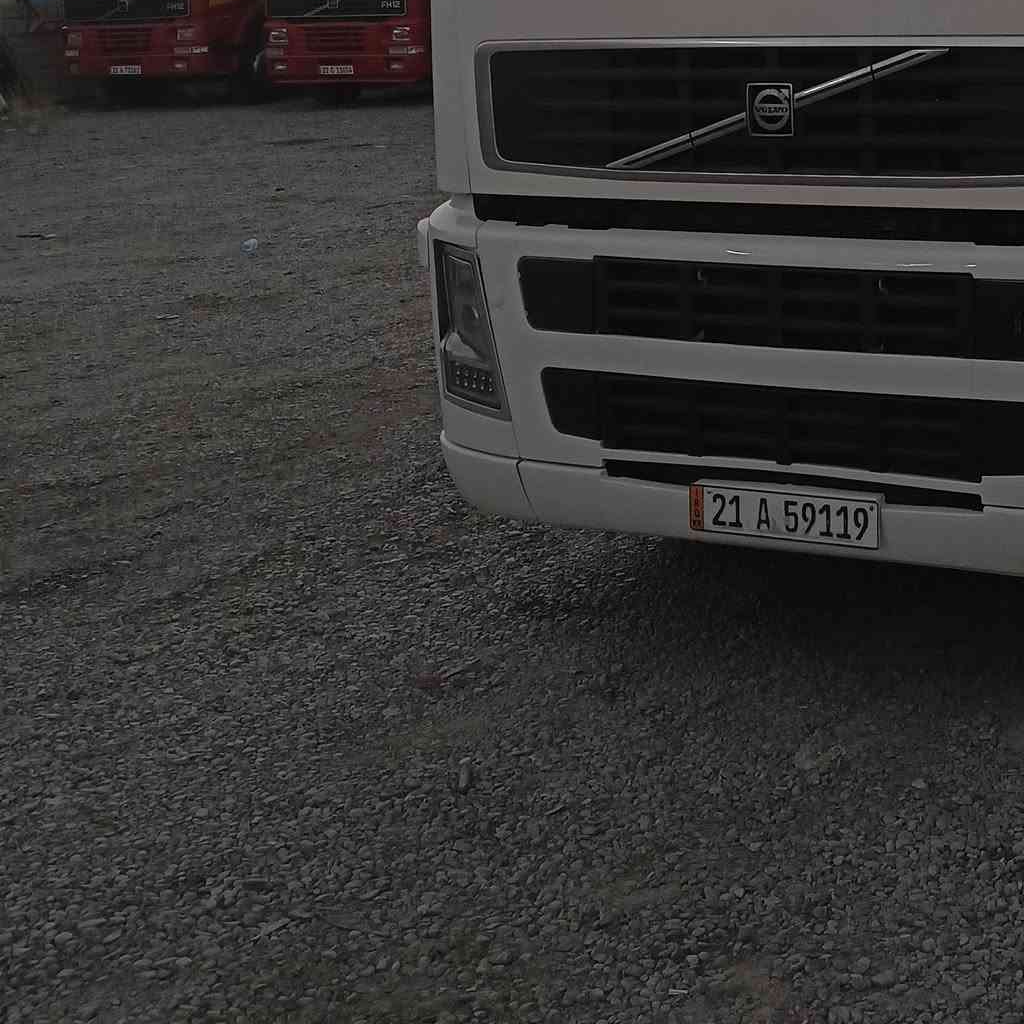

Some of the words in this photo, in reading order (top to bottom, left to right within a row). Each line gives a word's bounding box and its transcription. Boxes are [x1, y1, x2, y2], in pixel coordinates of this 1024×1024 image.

[712, 493, 743, 528] 21
[757, 497, 771, 530] A
[783, 500, 869, 541] 59119
